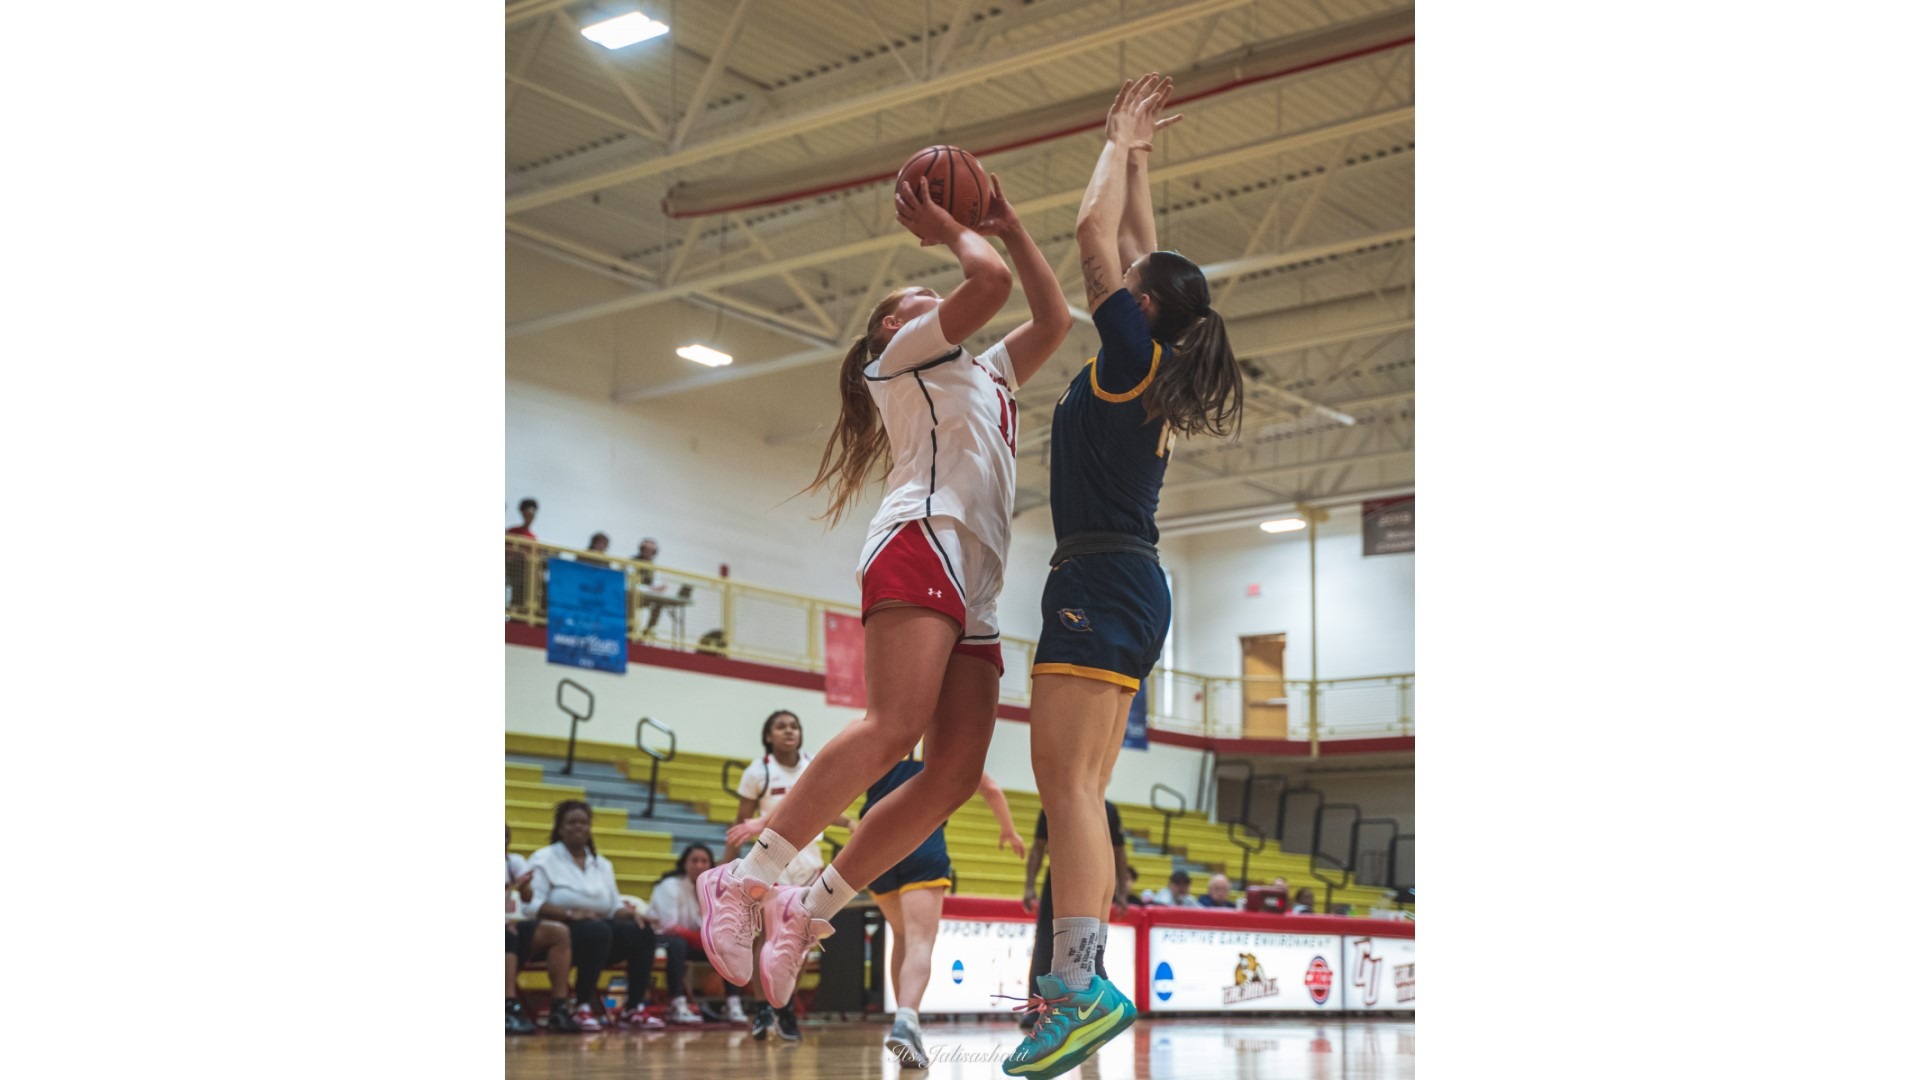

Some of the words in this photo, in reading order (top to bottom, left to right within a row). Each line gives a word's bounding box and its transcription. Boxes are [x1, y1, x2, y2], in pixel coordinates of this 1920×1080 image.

[997, 923, 1026, 939] OUR
[1163, 930, 1214, 946] POSITIVE
[1255, 933, 1330, 948] ENVIRONMENT
